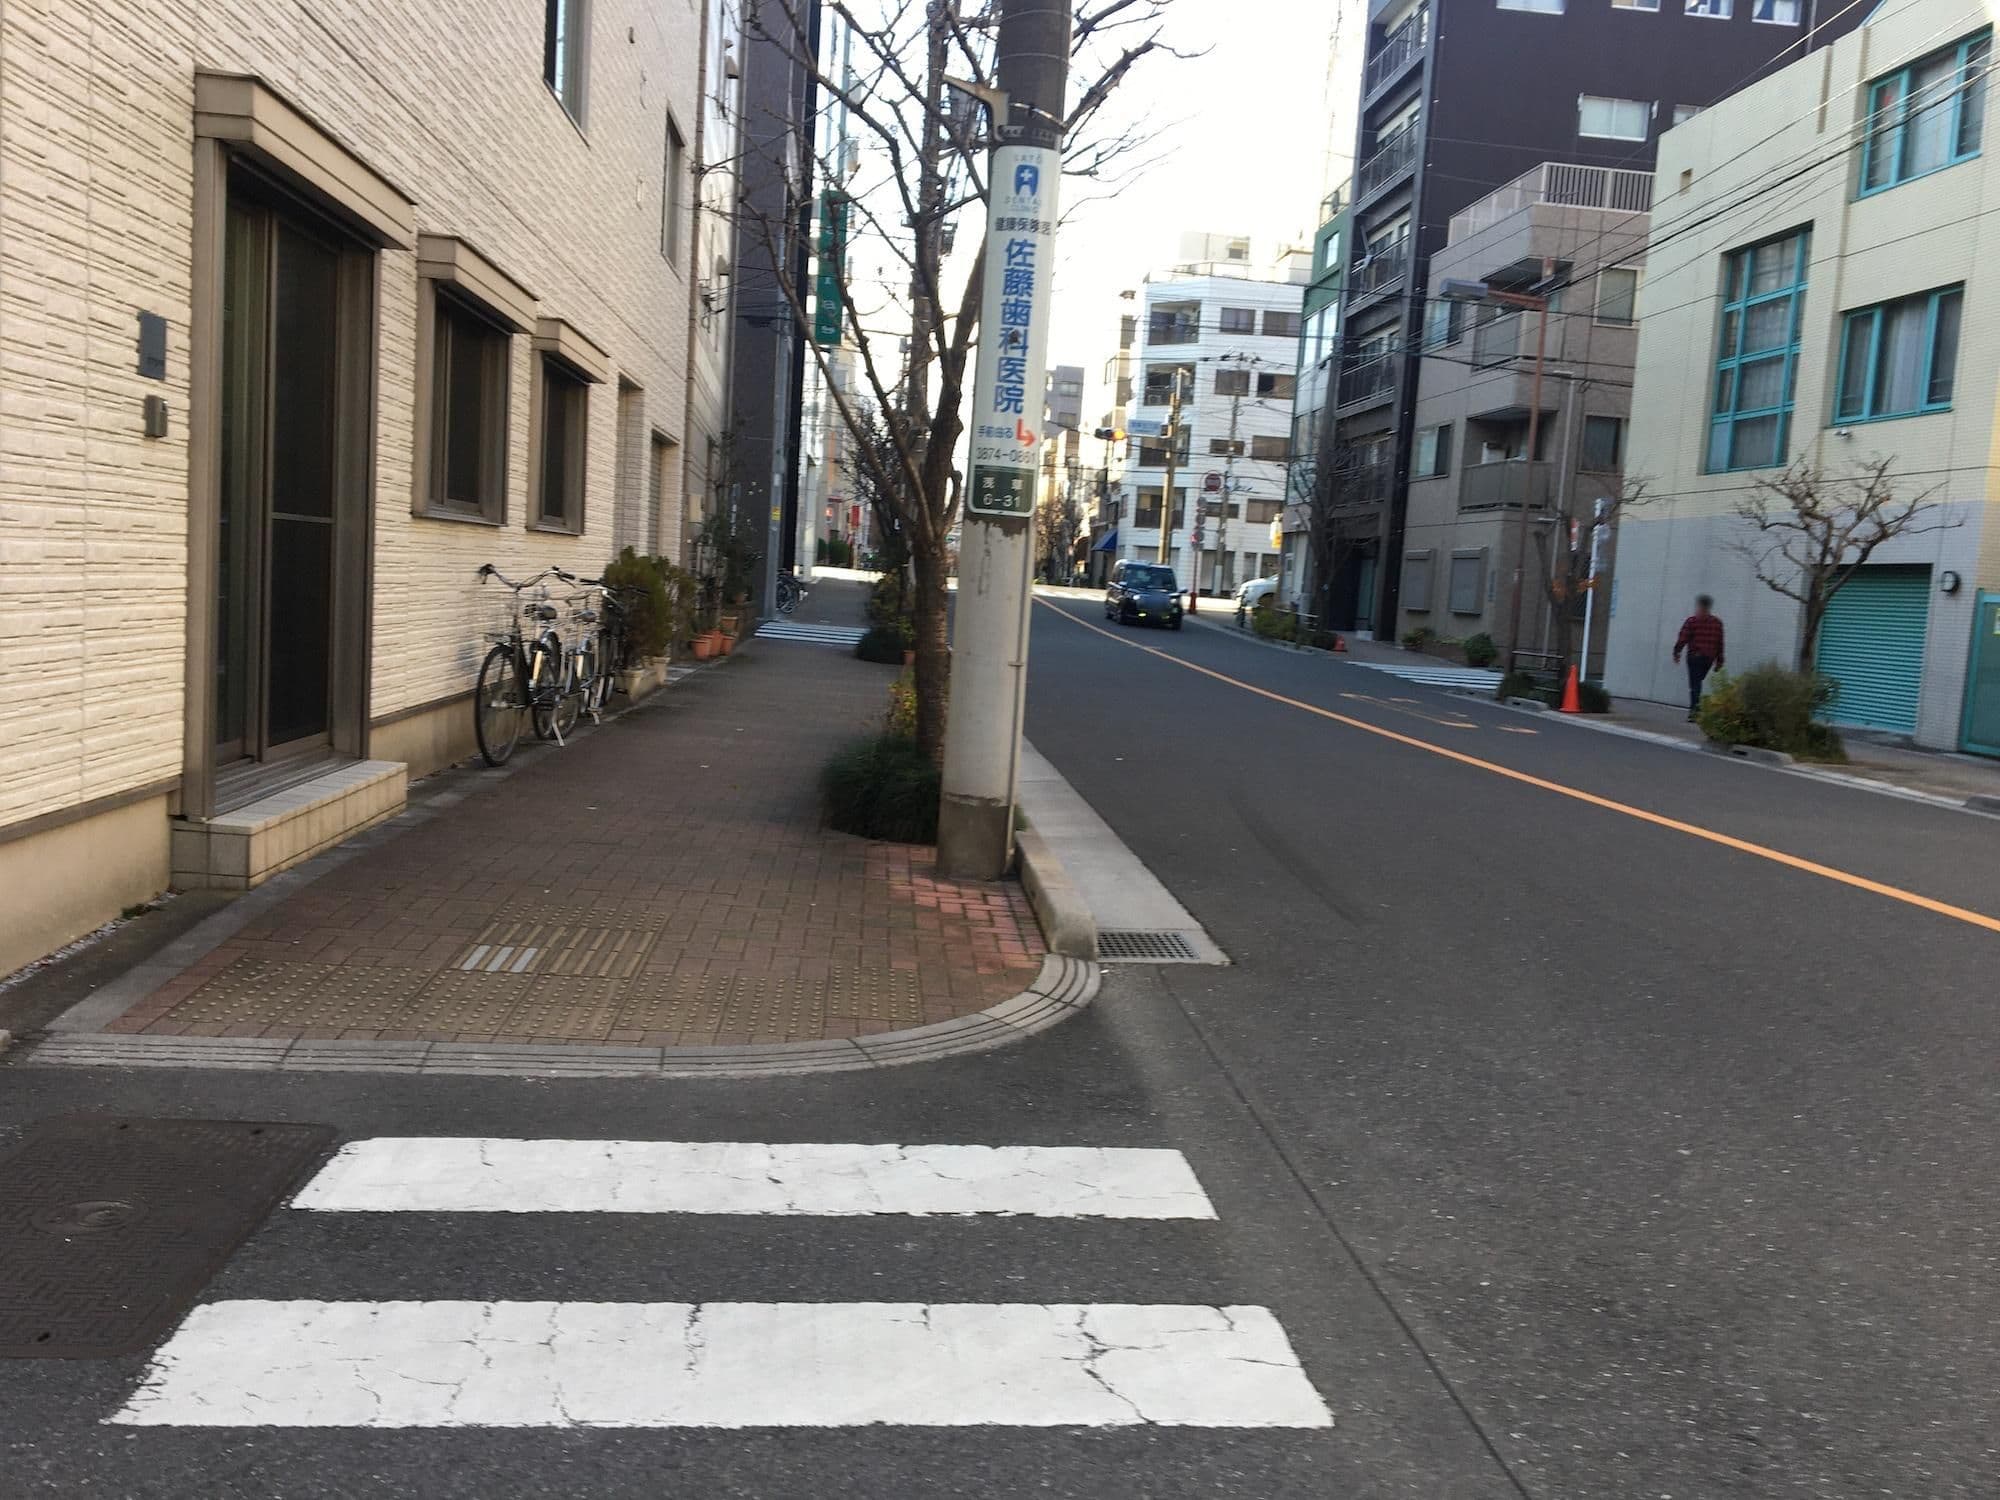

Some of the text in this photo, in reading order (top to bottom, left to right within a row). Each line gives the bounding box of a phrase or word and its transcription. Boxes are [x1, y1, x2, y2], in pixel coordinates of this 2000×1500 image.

[993, 238, 1036, 414] 佐藤歯科医院
[983, 493, 1021, 508] 6-31
